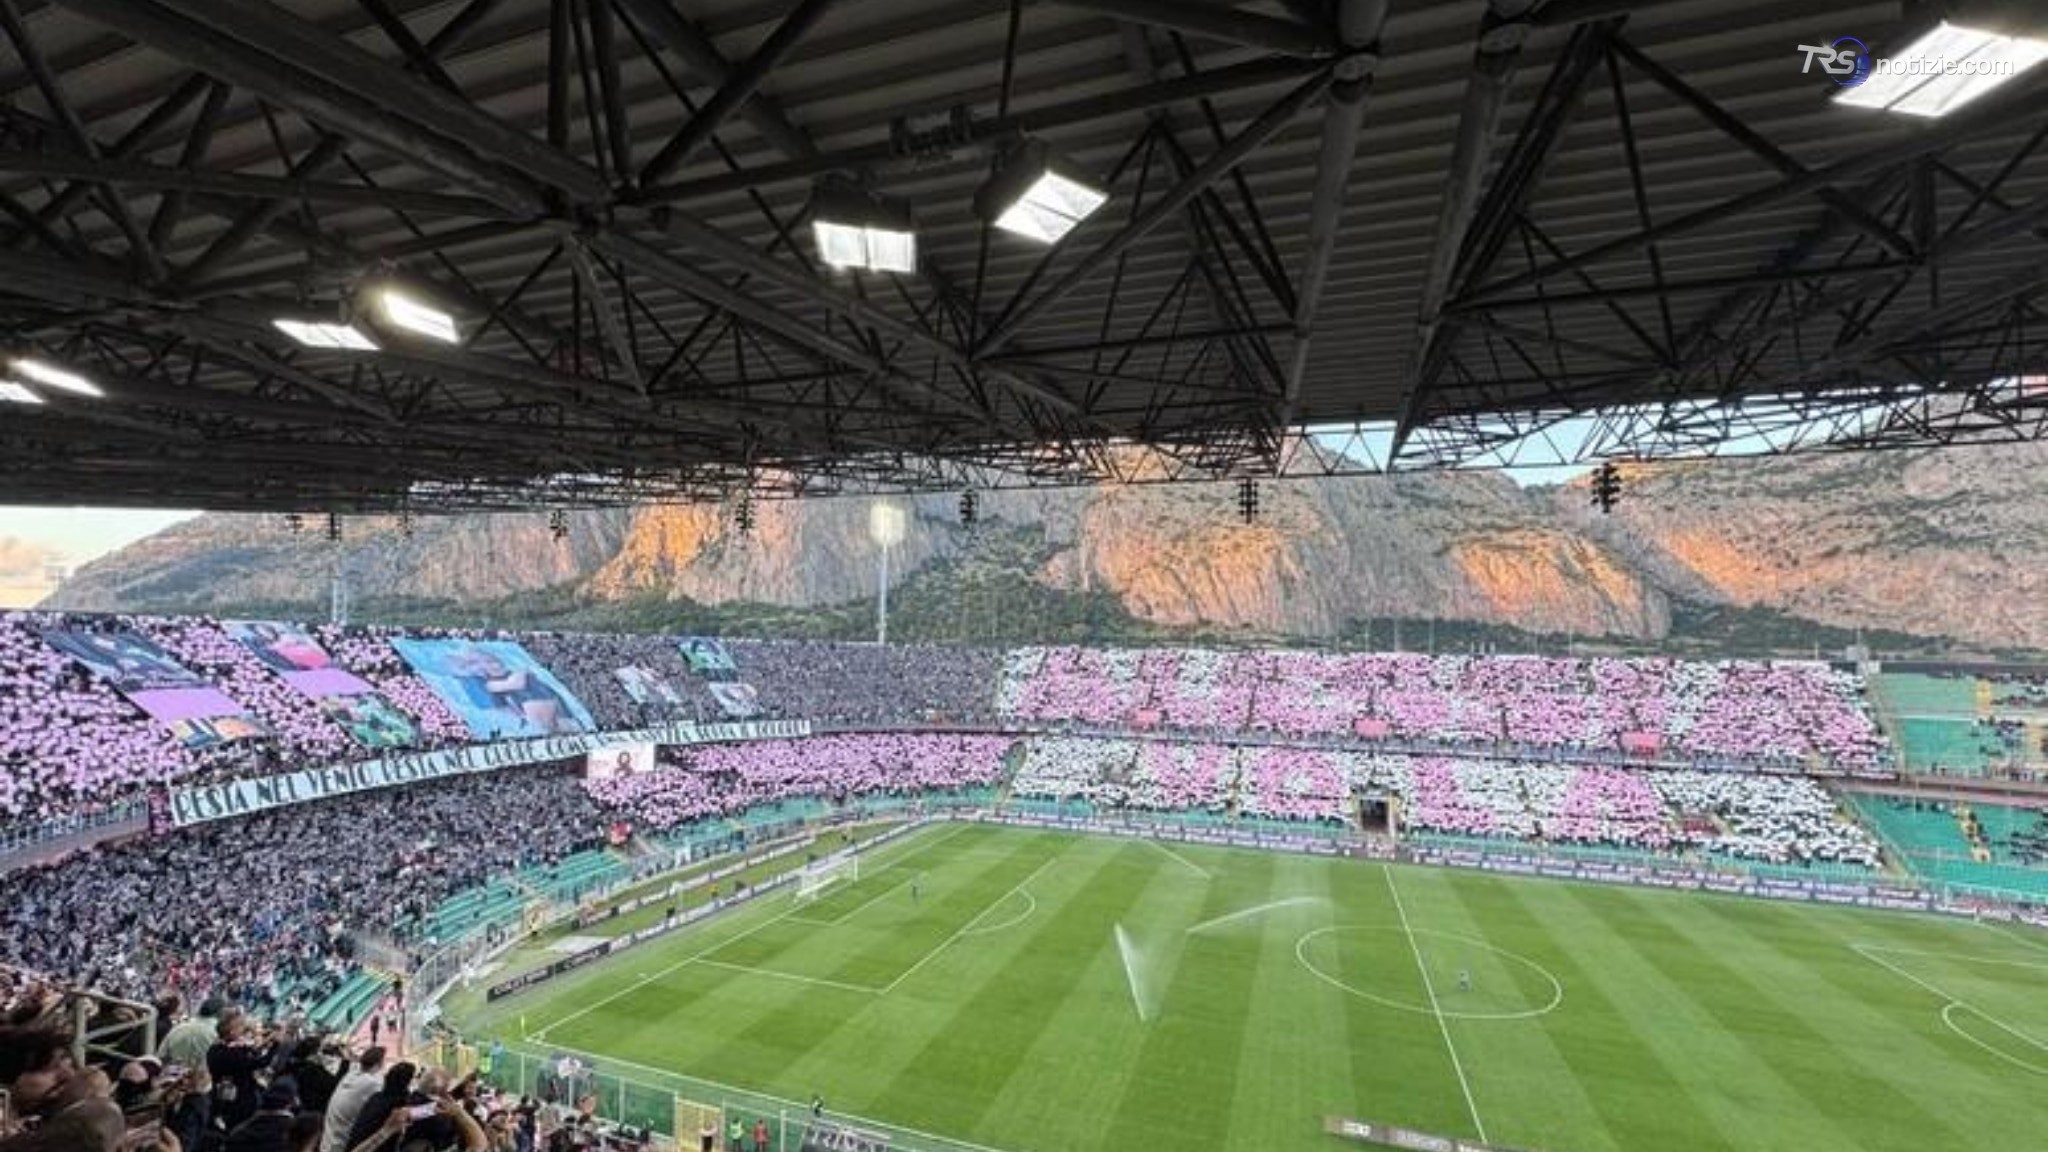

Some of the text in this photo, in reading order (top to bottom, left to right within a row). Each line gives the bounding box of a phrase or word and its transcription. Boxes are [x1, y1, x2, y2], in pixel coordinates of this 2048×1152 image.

[173, 781, 249, 824] RESTA
[255, 775, 298, 804] NEL
[444, 748, 475, 771] NEL
